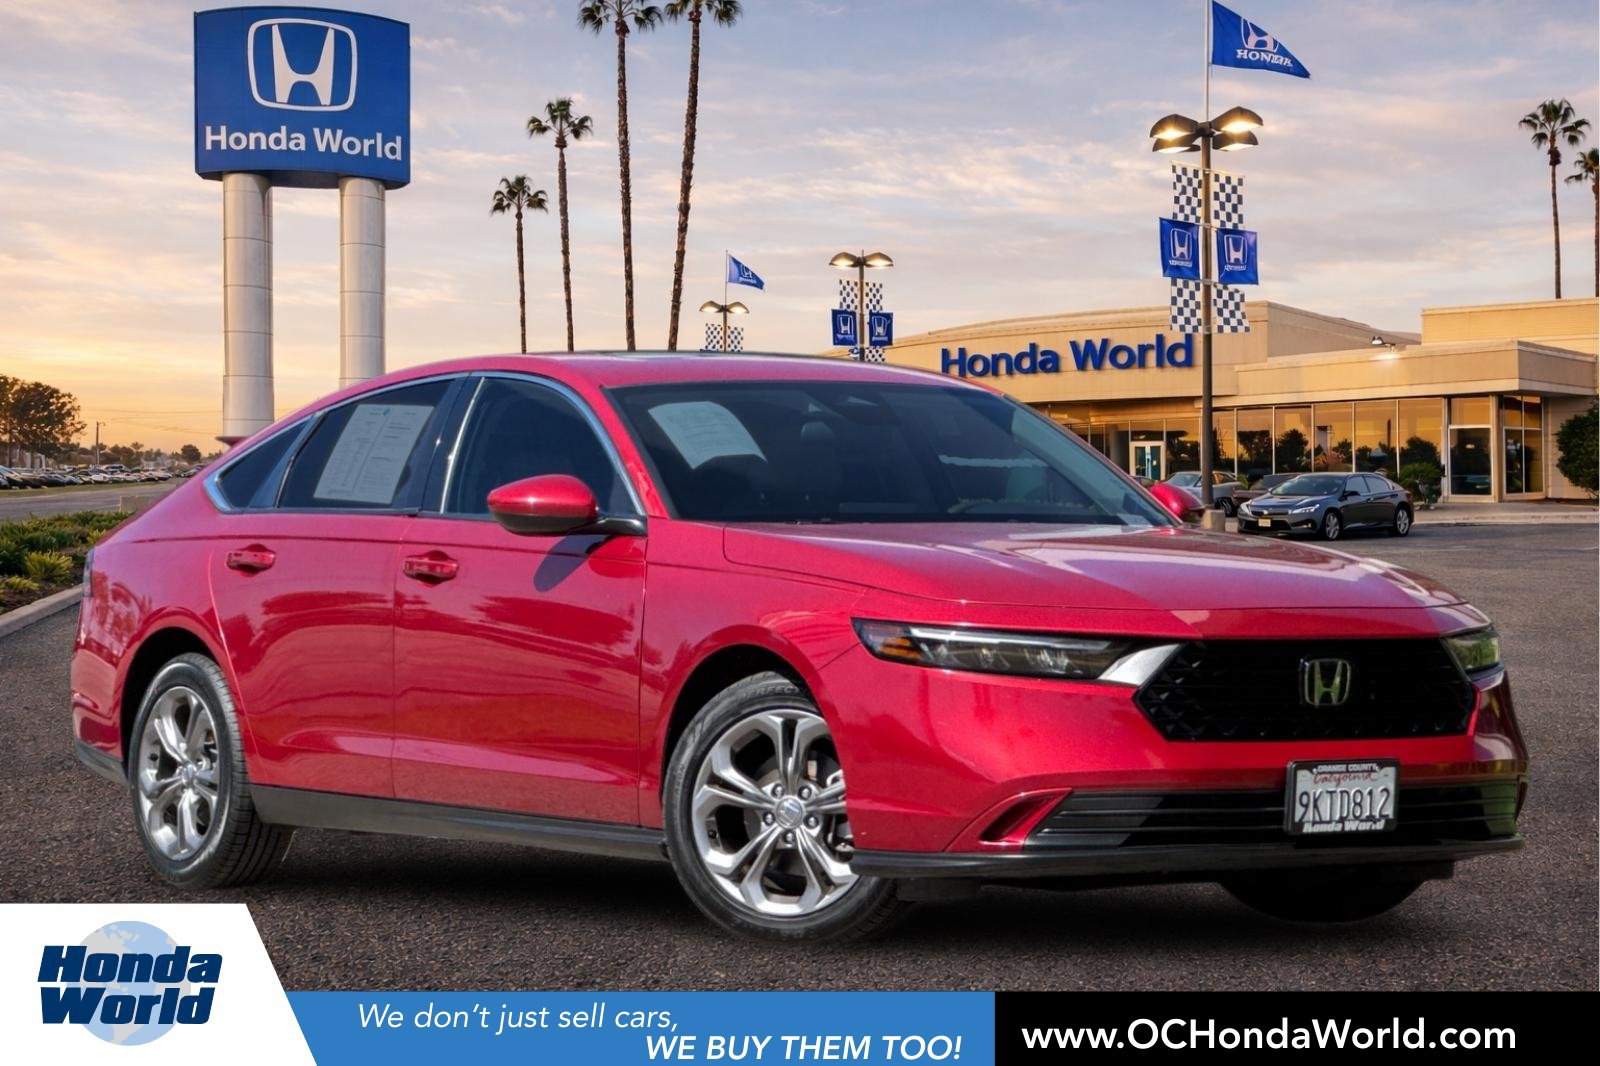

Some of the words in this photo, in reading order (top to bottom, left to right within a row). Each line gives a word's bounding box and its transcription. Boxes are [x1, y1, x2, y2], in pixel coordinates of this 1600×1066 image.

[205, 125, 306, 151] Honda
[312, 127, 402, 161] World
[941, 342, 1061, 378] Honda
[1069, 333, 1194, 372] World
[1348, 763, 1378, 772] COUNTY
[1298, 787, 1390, 821] 9KTD812
[1303, 821, 1343, 833] Honda
[1344, 820, 1386, 832] World
